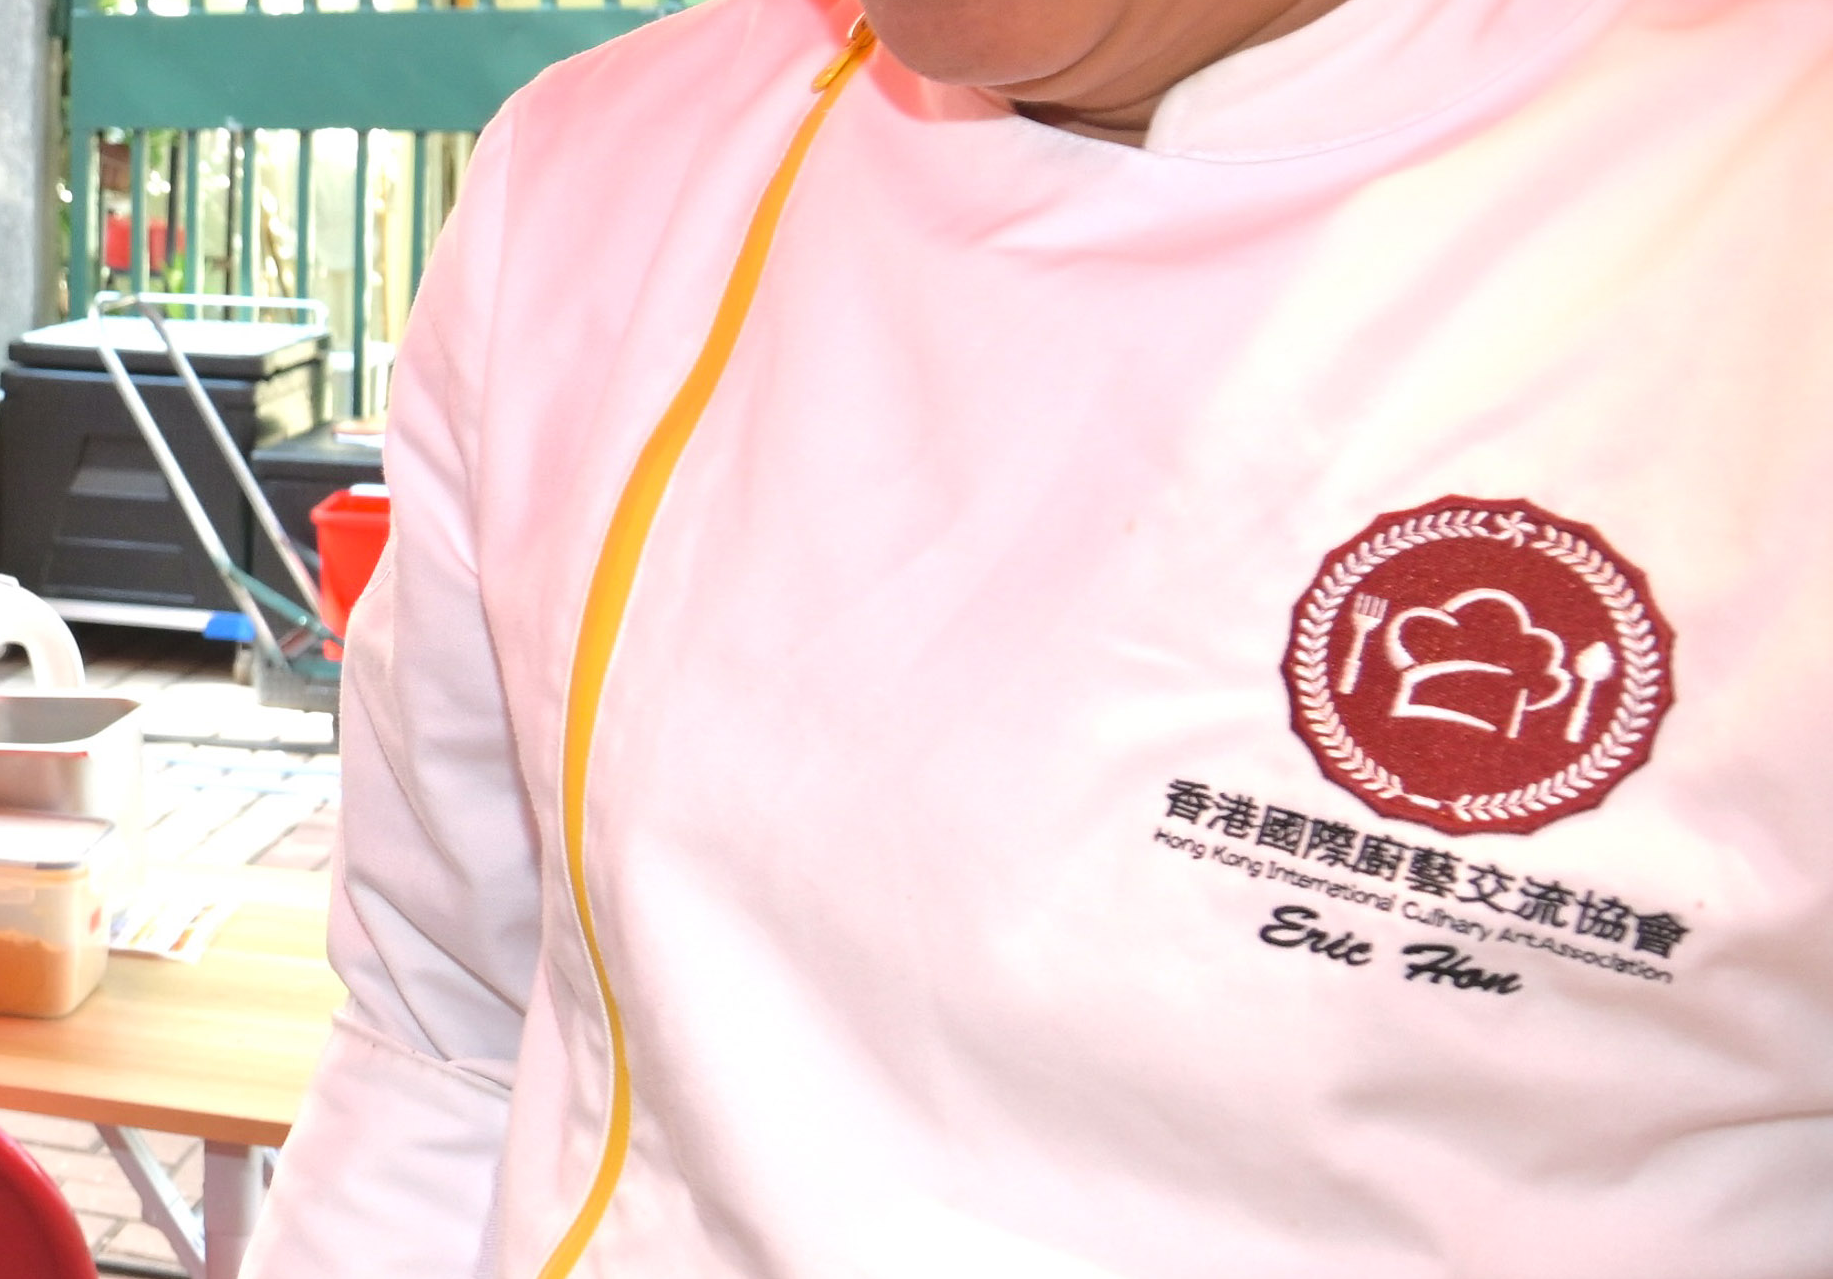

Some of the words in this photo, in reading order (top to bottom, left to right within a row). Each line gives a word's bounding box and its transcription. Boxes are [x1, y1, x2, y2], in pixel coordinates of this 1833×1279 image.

[1153, 827, 1207, 859] Hong
[1212, 845, 1264, 877] Kong
[1266, 860, 1396, 912] International
[1402, 900, 1493, 942] Culinary
[1166, 778, 1691, 959] 香港國際廚藝交流協會
[1259, 905, 1373, 966] Eric
[1402, 943, 1523, 995] Hon
